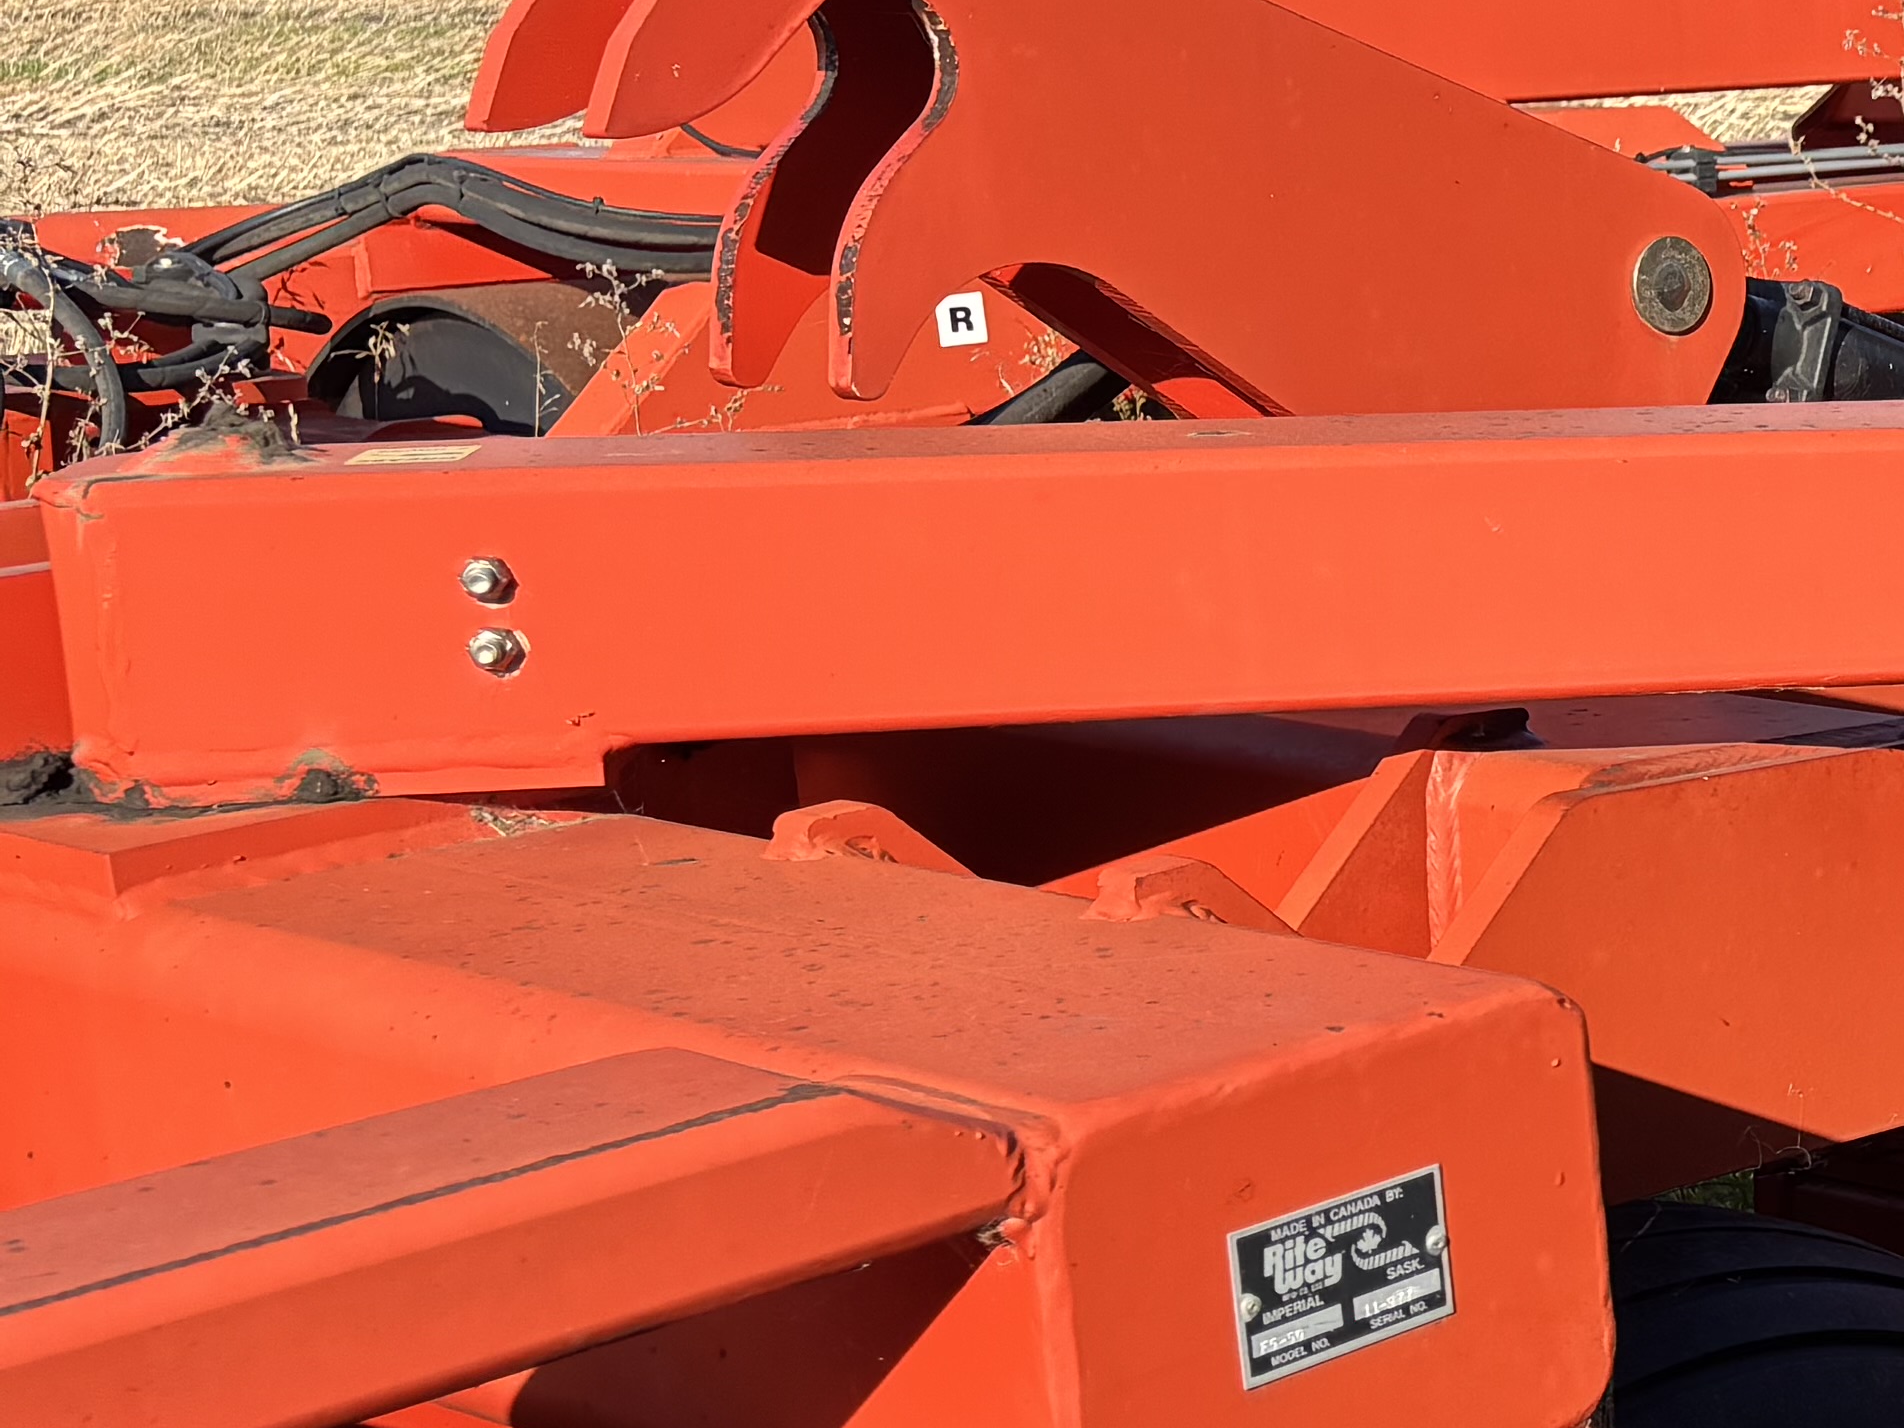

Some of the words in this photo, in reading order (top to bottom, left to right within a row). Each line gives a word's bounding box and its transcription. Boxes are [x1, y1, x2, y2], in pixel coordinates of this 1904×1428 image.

[949, 306, 974, 333] R
[1270, 1219, 1307, 1241] MADE
[1311, 1211, 1325, 1227] IN
[1329, 1194, 1381, 1221] CANADA
[1385, 1186, 1404, 1203] BY:
[1263, 1235, 1327, 1278] Rite
[1274, 1253, 1343, 1295] Way
[1262, 1294, 1325, 1325] IMPERIAL
[1369, 1309, 1406, 1329] SERIAL
[1271, 1345, 1308, 1366] MODEL
